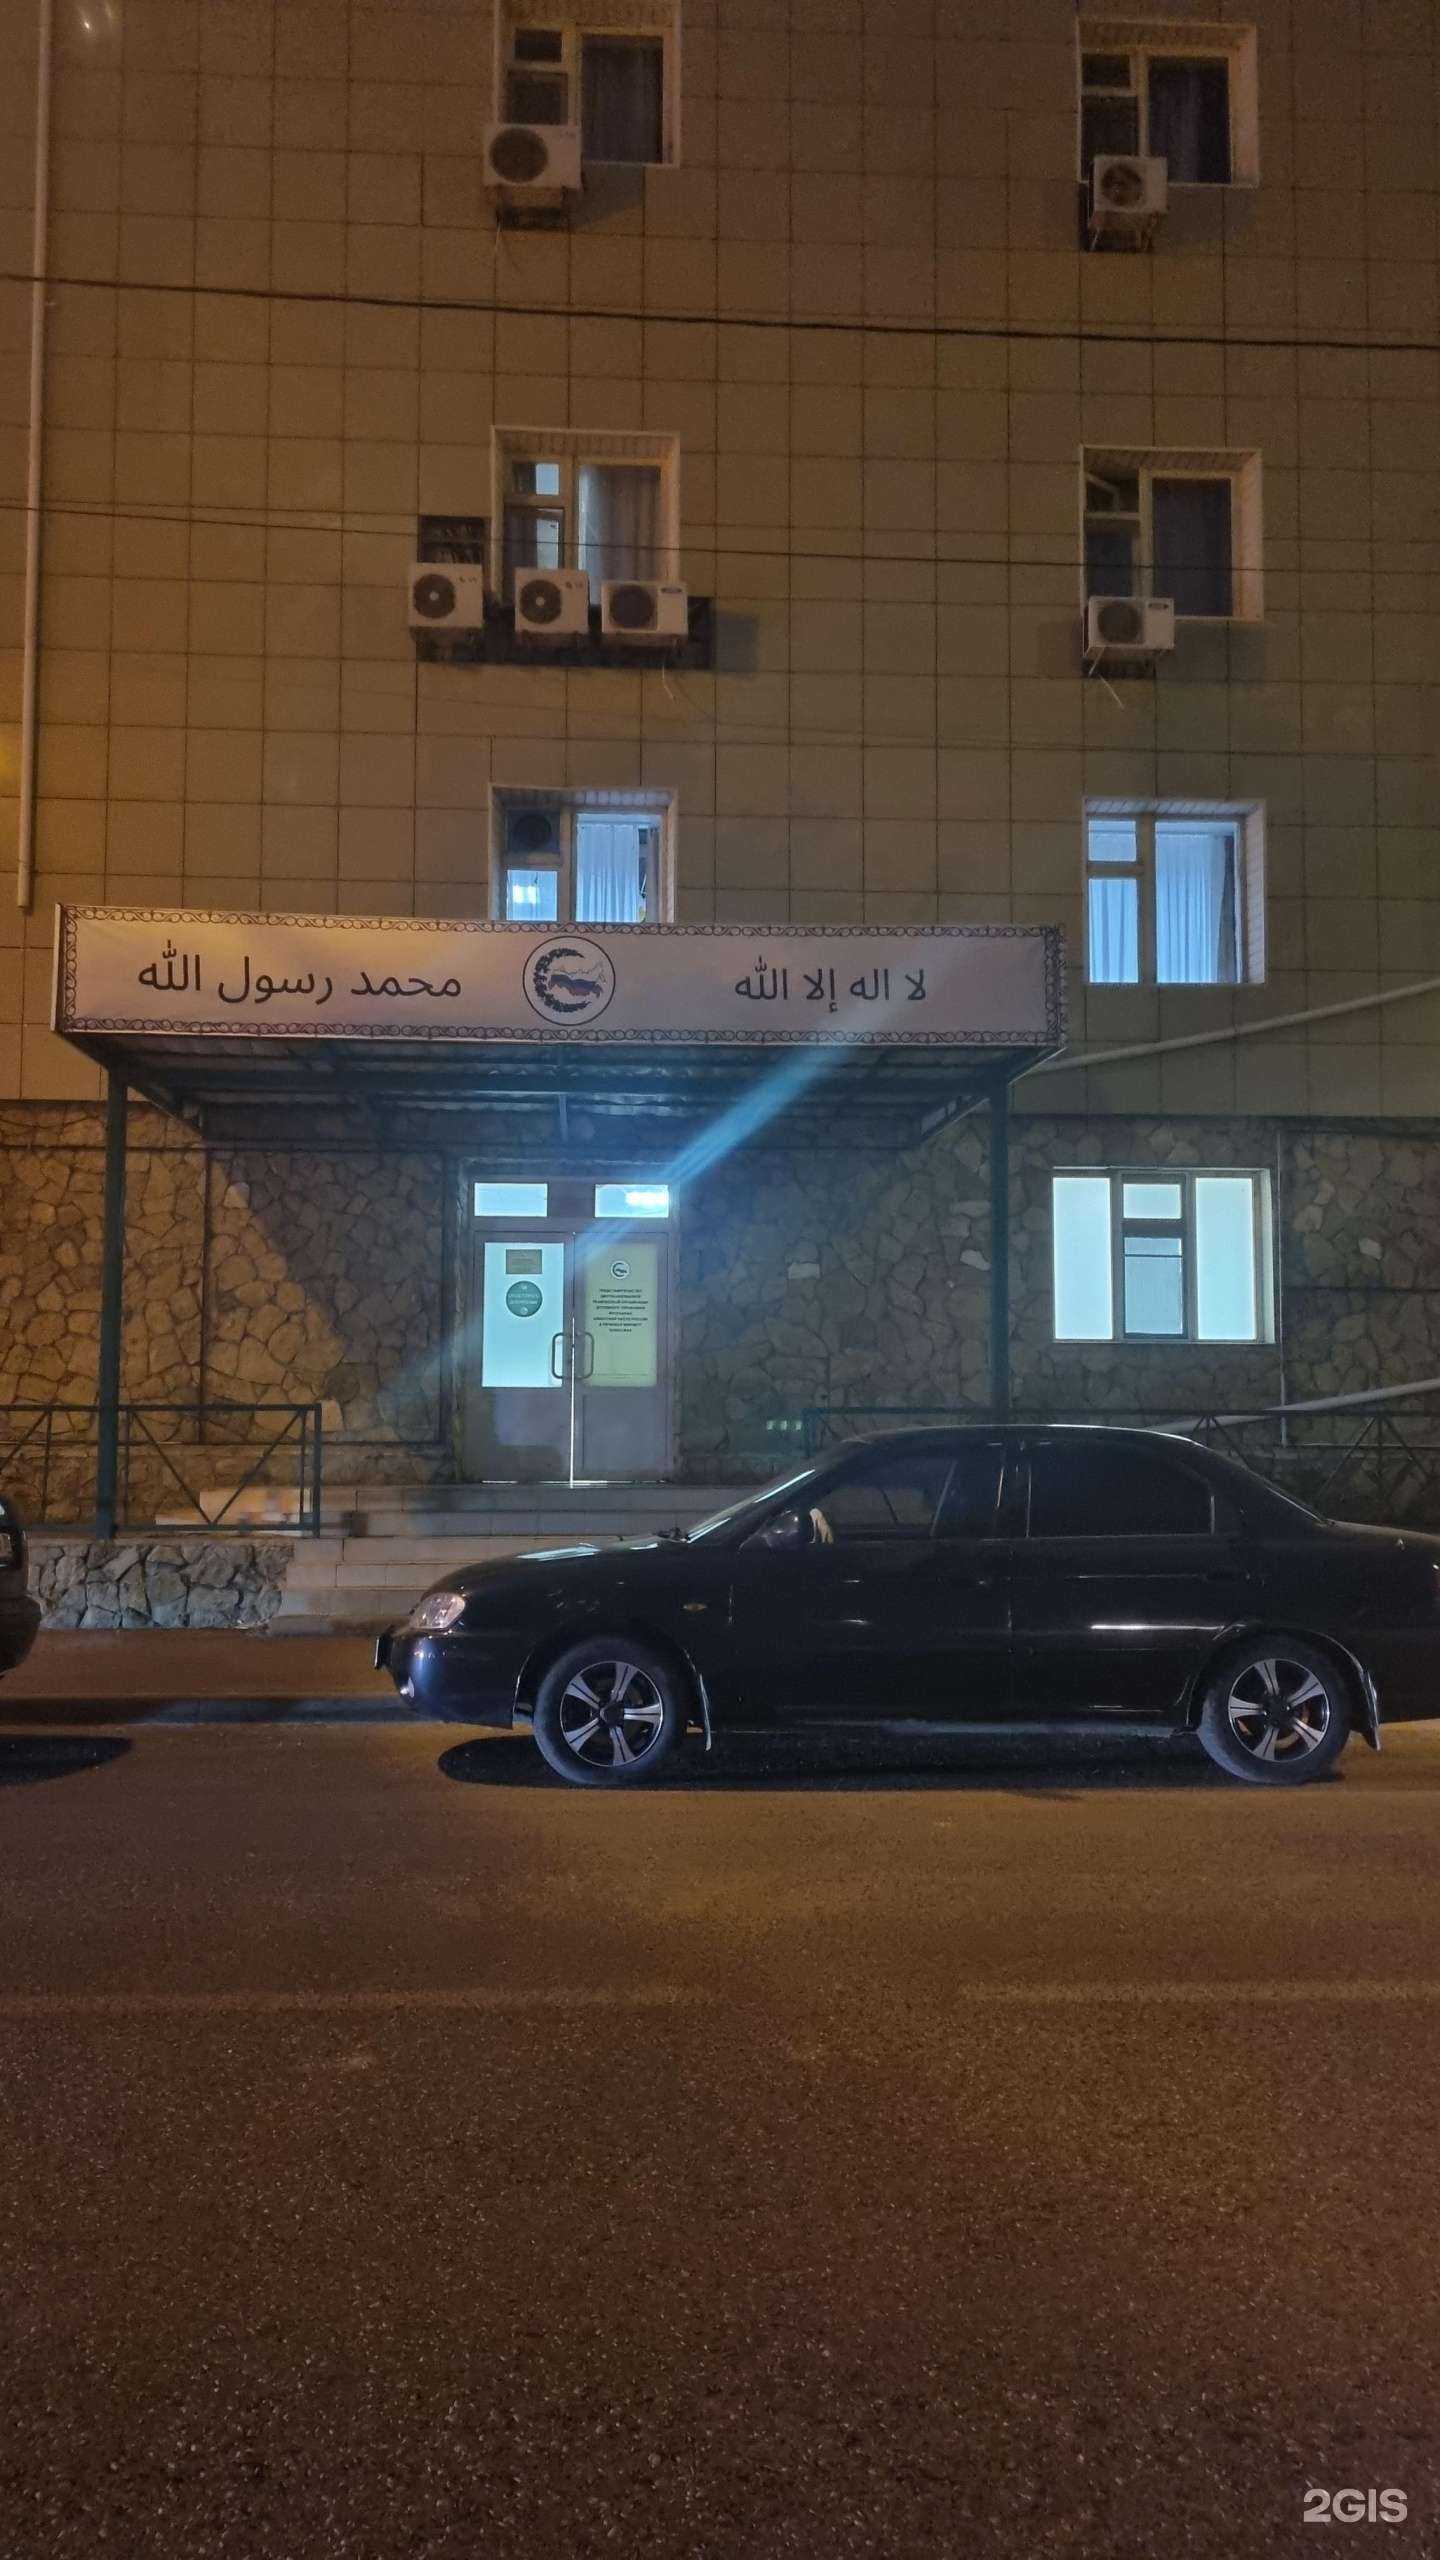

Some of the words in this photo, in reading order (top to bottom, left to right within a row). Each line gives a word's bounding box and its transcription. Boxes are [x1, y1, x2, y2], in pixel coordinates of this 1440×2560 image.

[137, 939, 201, 992] الله
[217, 956, 333, 1005] رسول
[350, 971, 462, 998] محمد
[735, 955, 788, 1001] الله
[905, 968, 926, 1001] لا
[802, 967, 839, 1013] إلا
